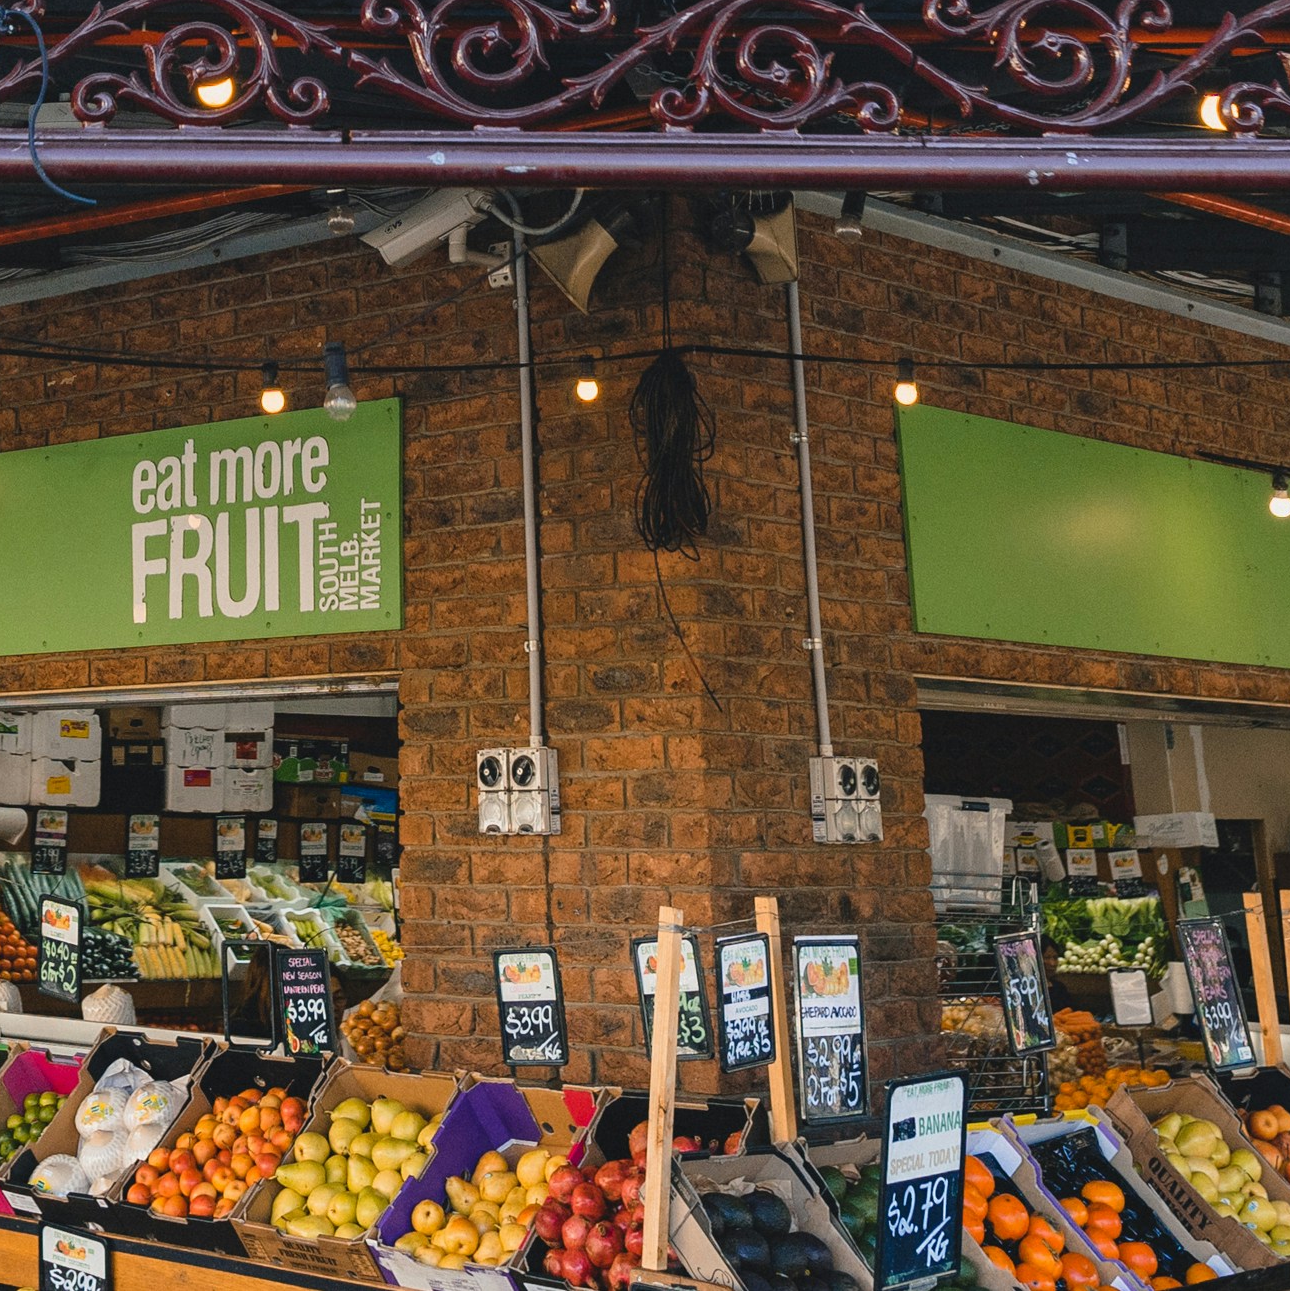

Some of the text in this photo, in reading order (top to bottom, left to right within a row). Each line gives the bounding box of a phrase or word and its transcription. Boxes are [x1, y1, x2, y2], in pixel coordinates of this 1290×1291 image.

[132, 436, 330, 514] eat more
[131, 501, 330, 623] FRUIT
[319, 522, 338, 612] SOUTH
[339, 532, 360, 611] MELB.
[360, 498, 381, 610] MARKET
[282, 971, 323, 981] NEW SEASON
[288, 957, 317, 968] SPECIAL
[287, 998, 327, 1023] $3.99
[505, 1005, 553, 1039] $3.99
[918, 1110, 963, 1136] BANANA
[890, 1154, 926, 1177] SPECIAL
[1148, 1157, 1214, 1230] QUALITY
[888, 1176, 949, 1238] $2.79
